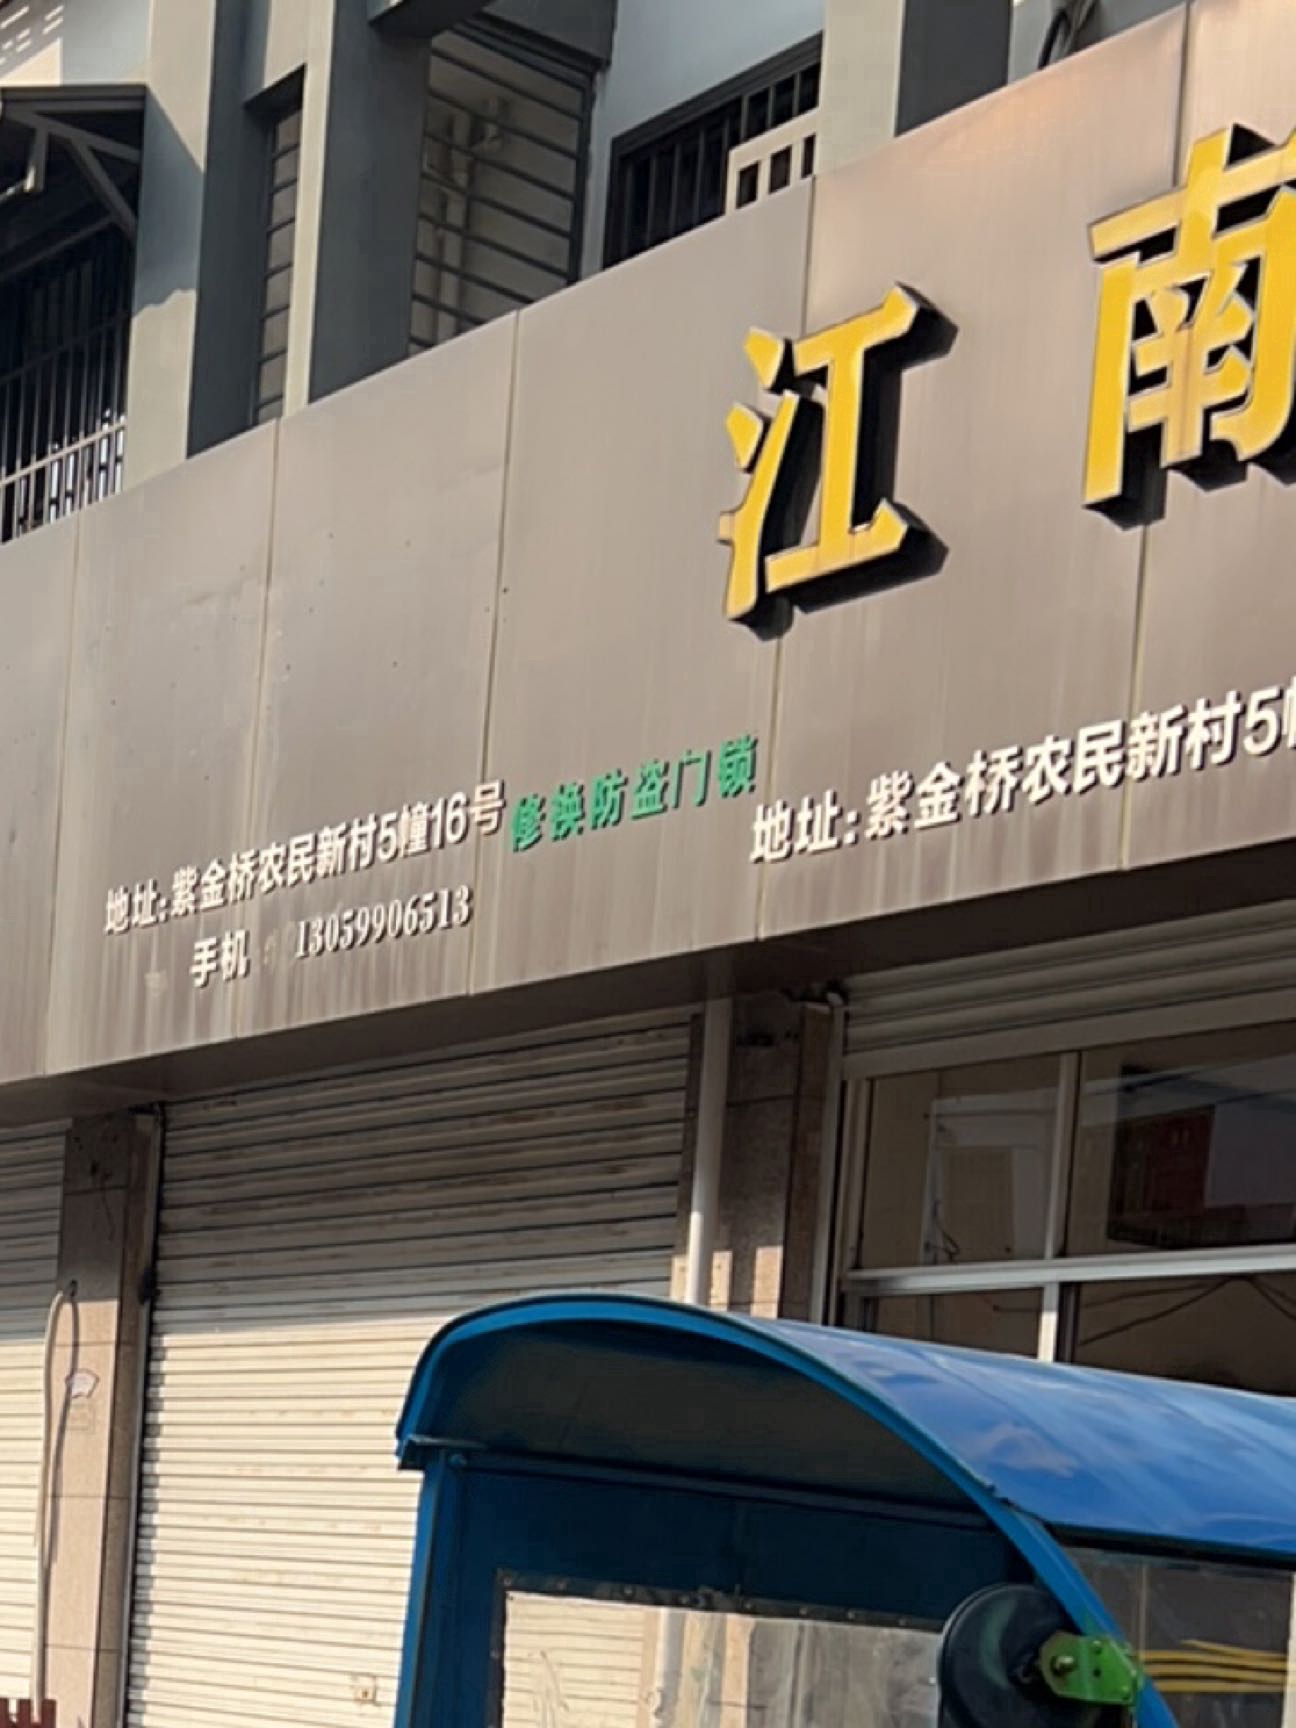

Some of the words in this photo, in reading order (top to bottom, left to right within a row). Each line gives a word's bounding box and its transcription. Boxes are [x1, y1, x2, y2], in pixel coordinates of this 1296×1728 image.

[510, 733, 759, 852] 修换防盗门锁
[190, 925, 252, 988] 手机
